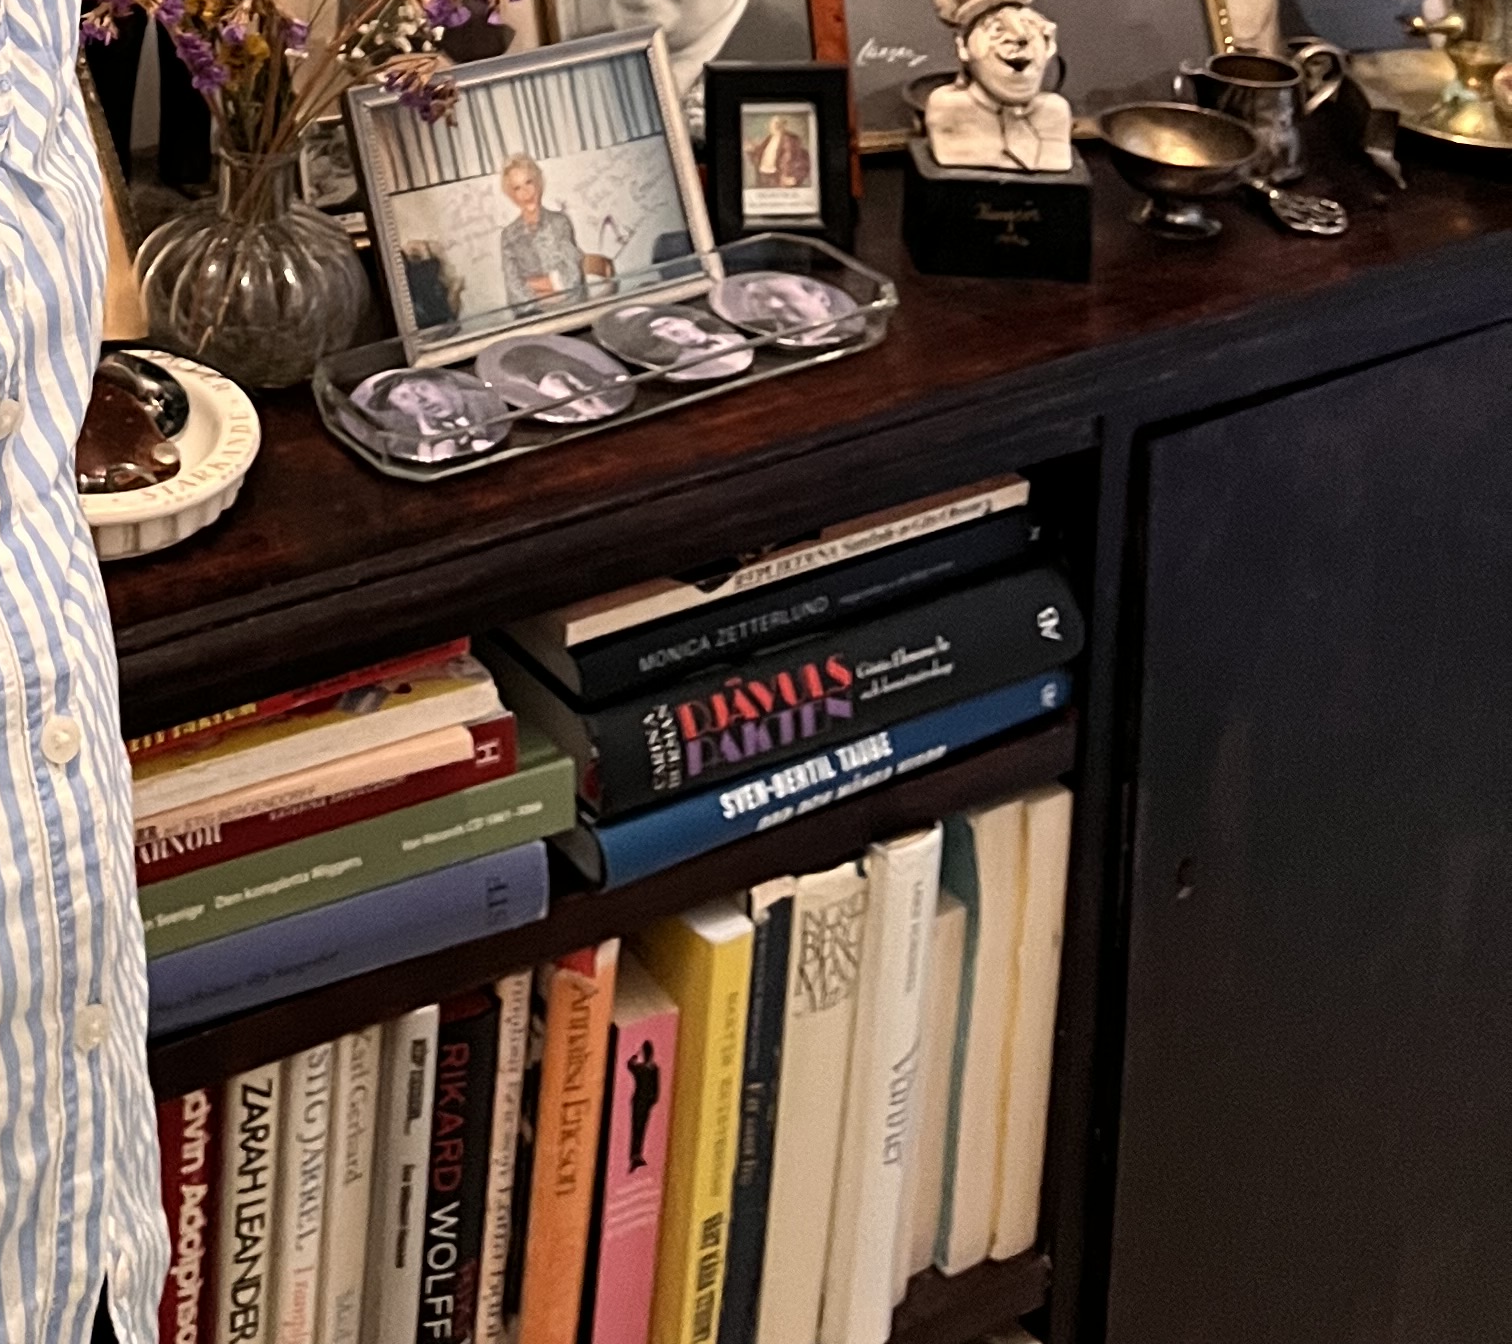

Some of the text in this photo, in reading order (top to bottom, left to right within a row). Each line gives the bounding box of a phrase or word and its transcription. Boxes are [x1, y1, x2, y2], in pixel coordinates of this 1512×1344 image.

[639, 595, 831, 673] MONICA ZETTERLUND
[228, 1077, 274, 1344] ZARAH LEANDER
[304, 1050, 333, 1125] STIG
[421, 1041, 470, 1340] RIKARD WOLFF
[169, 1090, 213, 1344] dvin Adolphso
